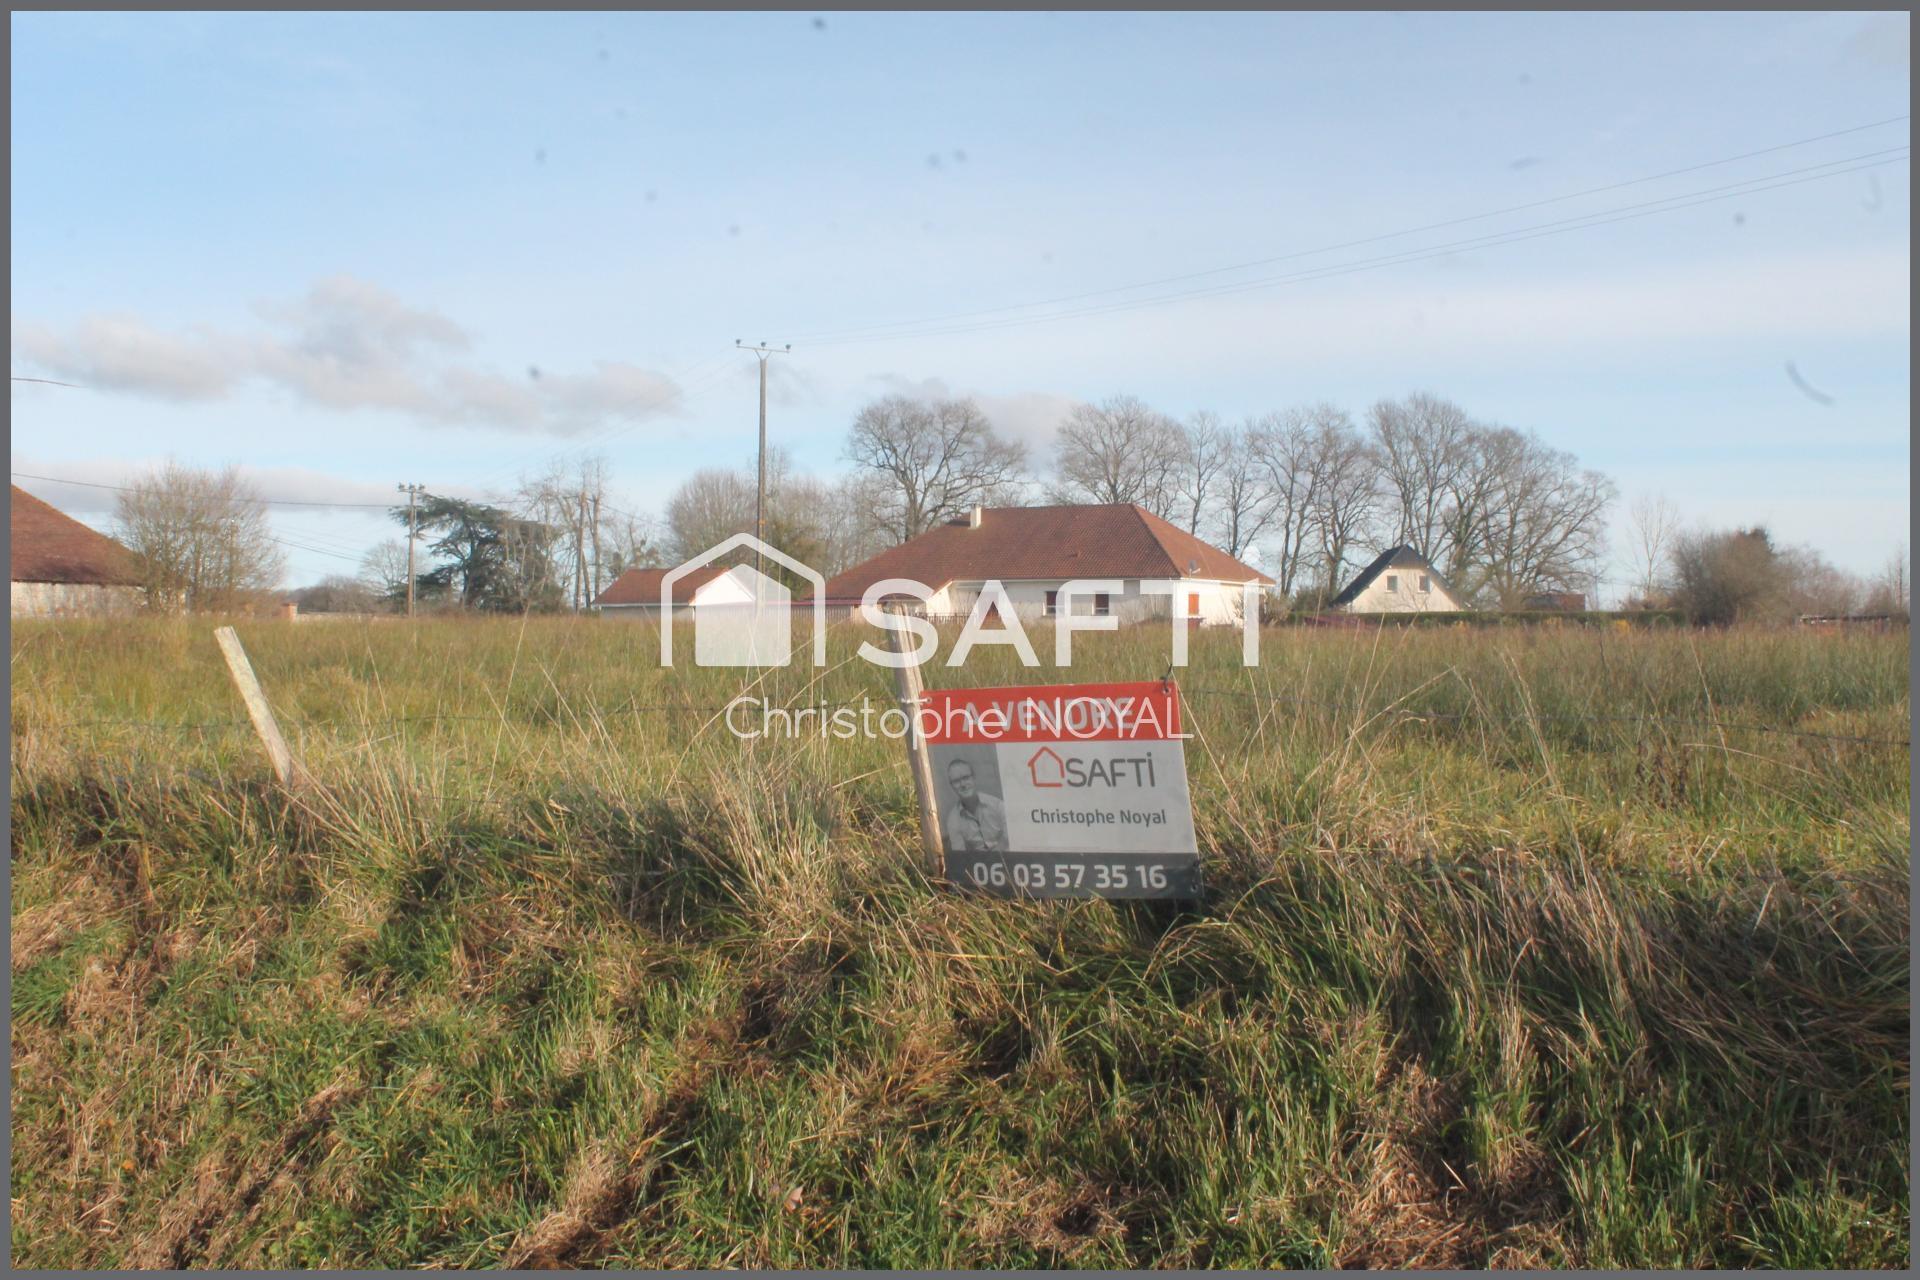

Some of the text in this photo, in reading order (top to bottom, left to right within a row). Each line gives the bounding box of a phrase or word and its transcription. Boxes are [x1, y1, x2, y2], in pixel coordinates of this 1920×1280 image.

[990, 697, 1136, 732] VENDRE
[1031, 808, 1168, 828] Christophe Noyal
[973, 862, 1168, 890] 06 03 57 35 16
